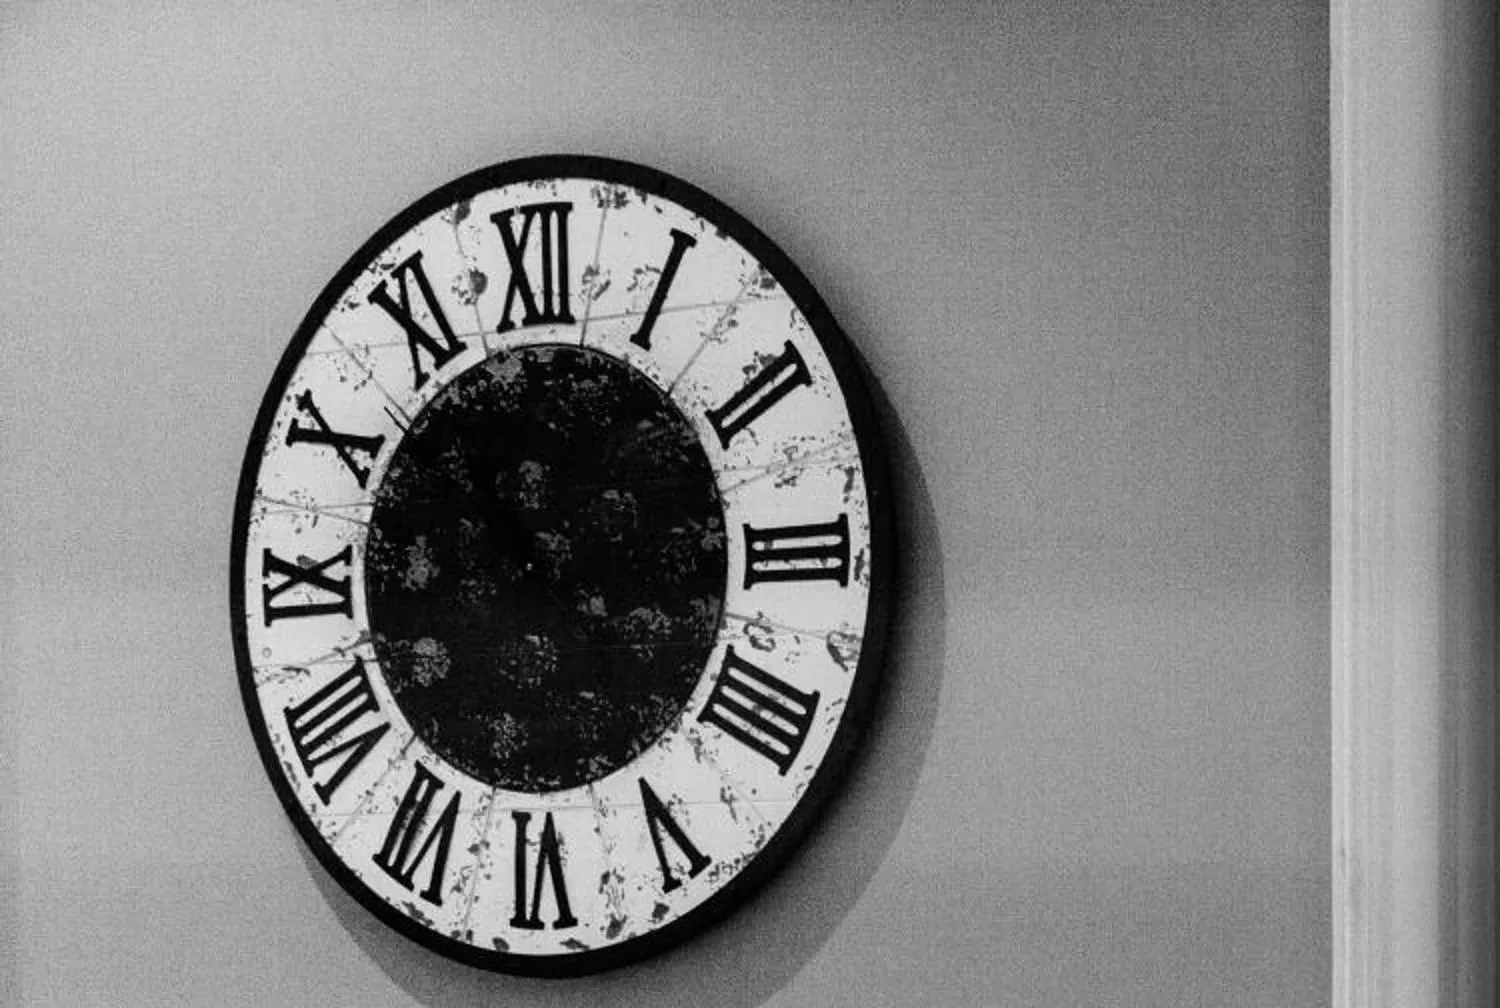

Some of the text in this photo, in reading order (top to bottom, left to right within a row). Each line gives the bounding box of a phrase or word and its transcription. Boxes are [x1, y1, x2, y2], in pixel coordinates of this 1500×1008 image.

[368, 251, 467, 391] XI
[490, 202, 576, 333] XII
[630, 229, 697, 351] I
[286, 390, 385, 489] X
[706, 340, 812, 450] II
[263, 545, 354, 626] IX
[743, 513, 850, 590] III
[284, 656, 391, 805] VIII
[697, 645, 820, 776] IIII
[373, 761, 460, 906] VII
[510, 811, 578, 930] VI
[639, 778, 712, 893] V
